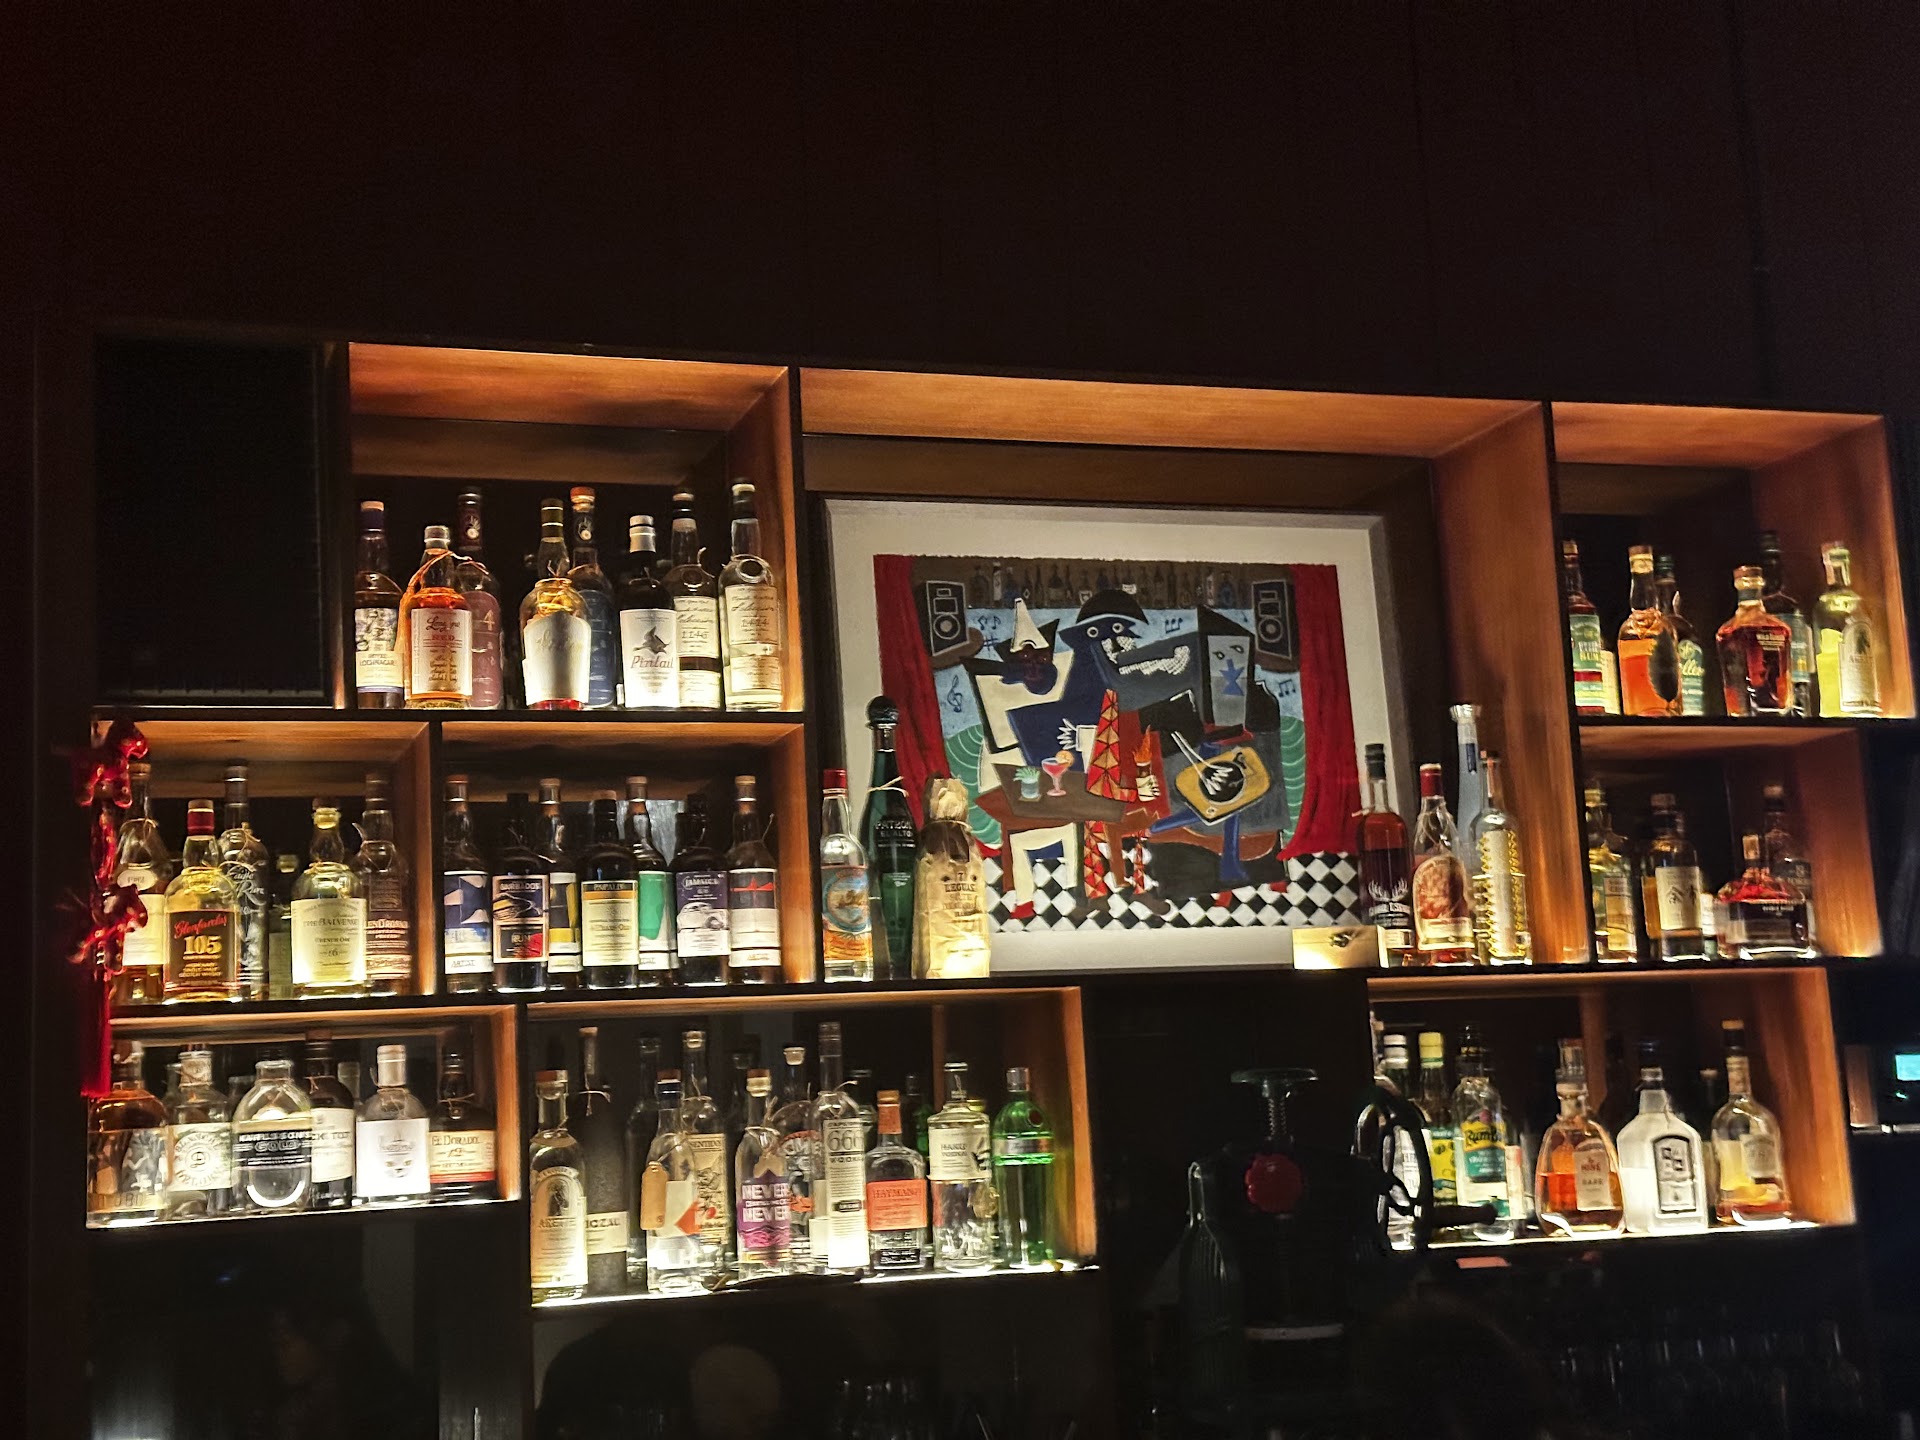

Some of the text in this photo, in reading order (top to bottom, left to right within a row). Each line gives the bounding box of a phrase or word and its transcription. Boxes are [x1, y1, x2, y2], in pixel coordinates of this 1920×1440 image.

[631, 655, 673, 668] Pintail
[183, 935, 222, 955] 105
[254, 1140, 301, 1152] GOLD
[432, 1135, 479, 1146] EL DORADO
[742, 1183, 789, 1199] NEVER
[743, 1205, 790, 1222] NEVER
